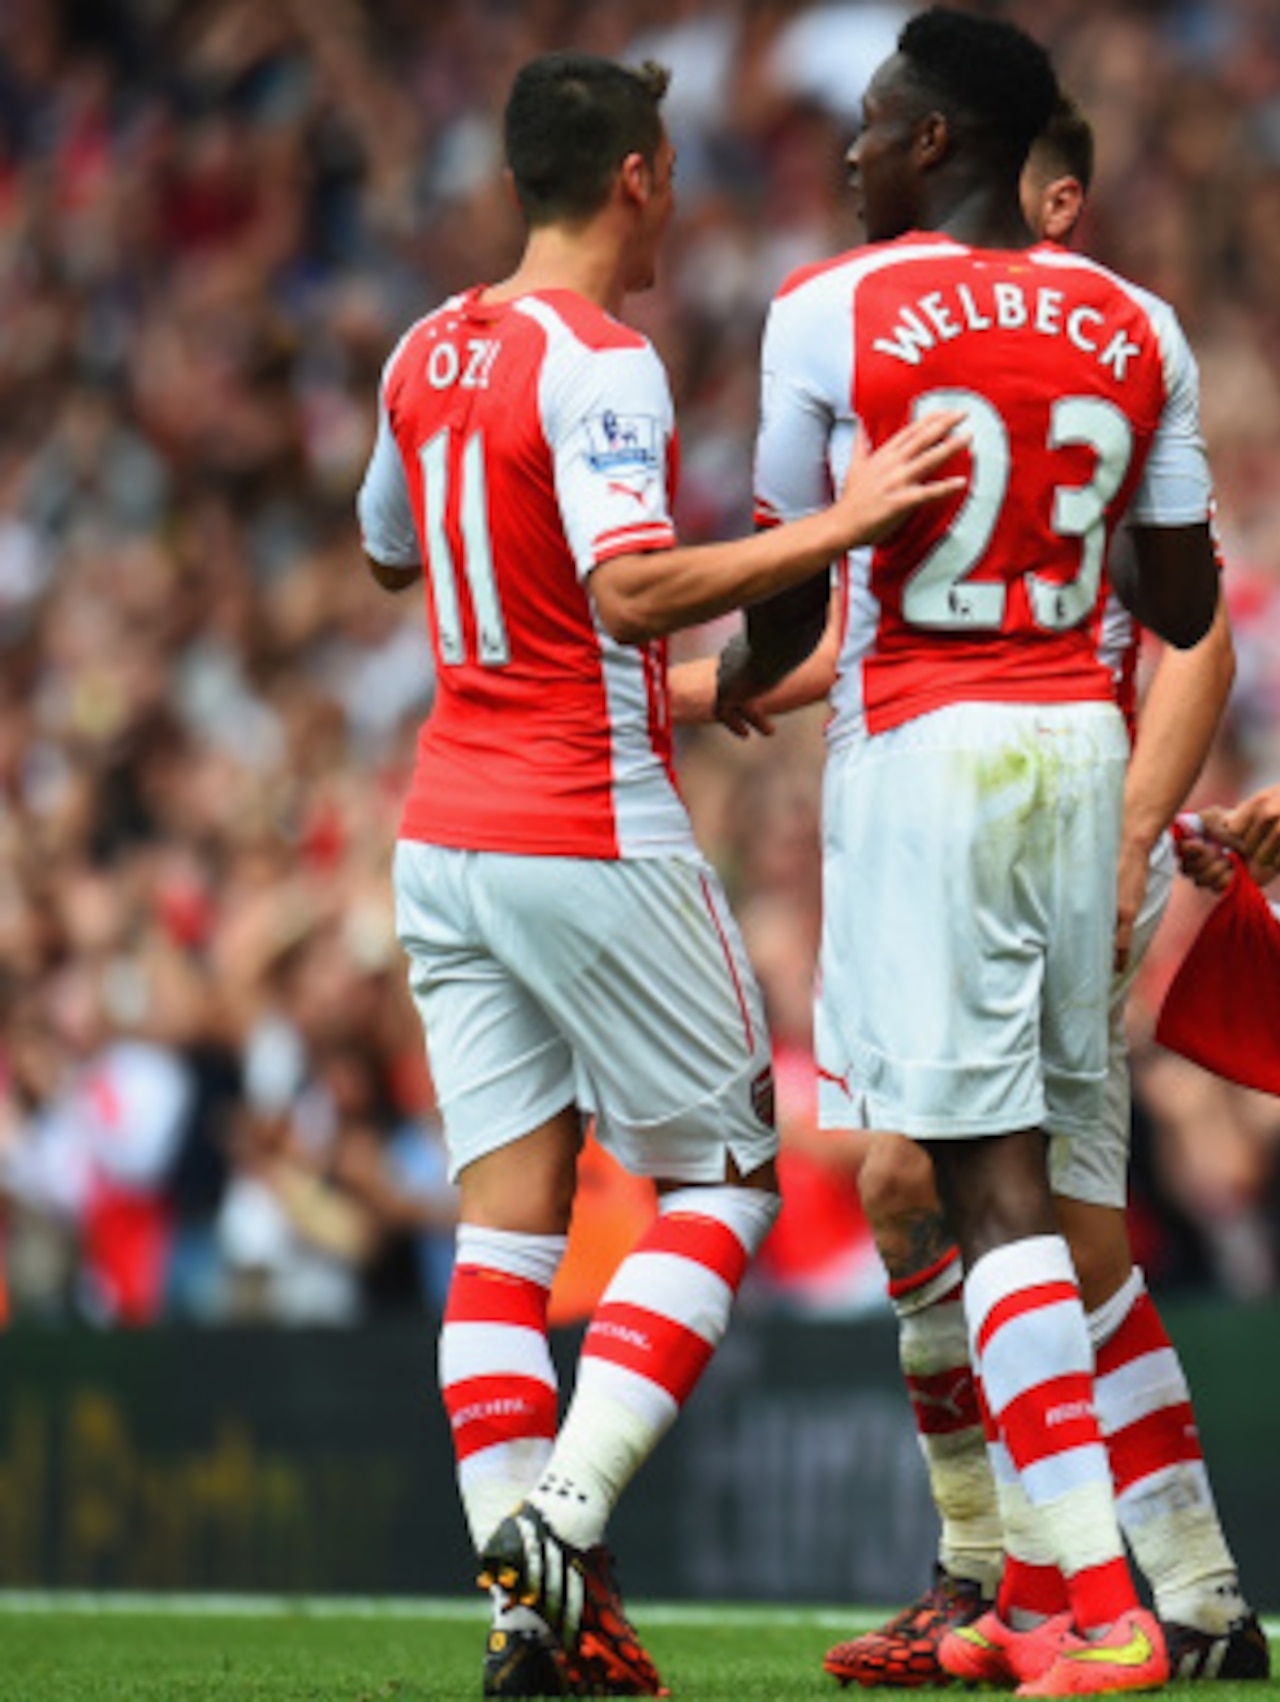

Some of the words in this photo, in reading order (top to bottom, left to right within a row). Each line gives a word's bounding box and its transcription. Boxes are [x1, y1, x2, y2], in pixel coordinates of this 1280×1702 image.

[872, 283, 1141, 381] WELBECK
[418, 426, 511, 666] 11
[902, 388, 1134, 632] 23
